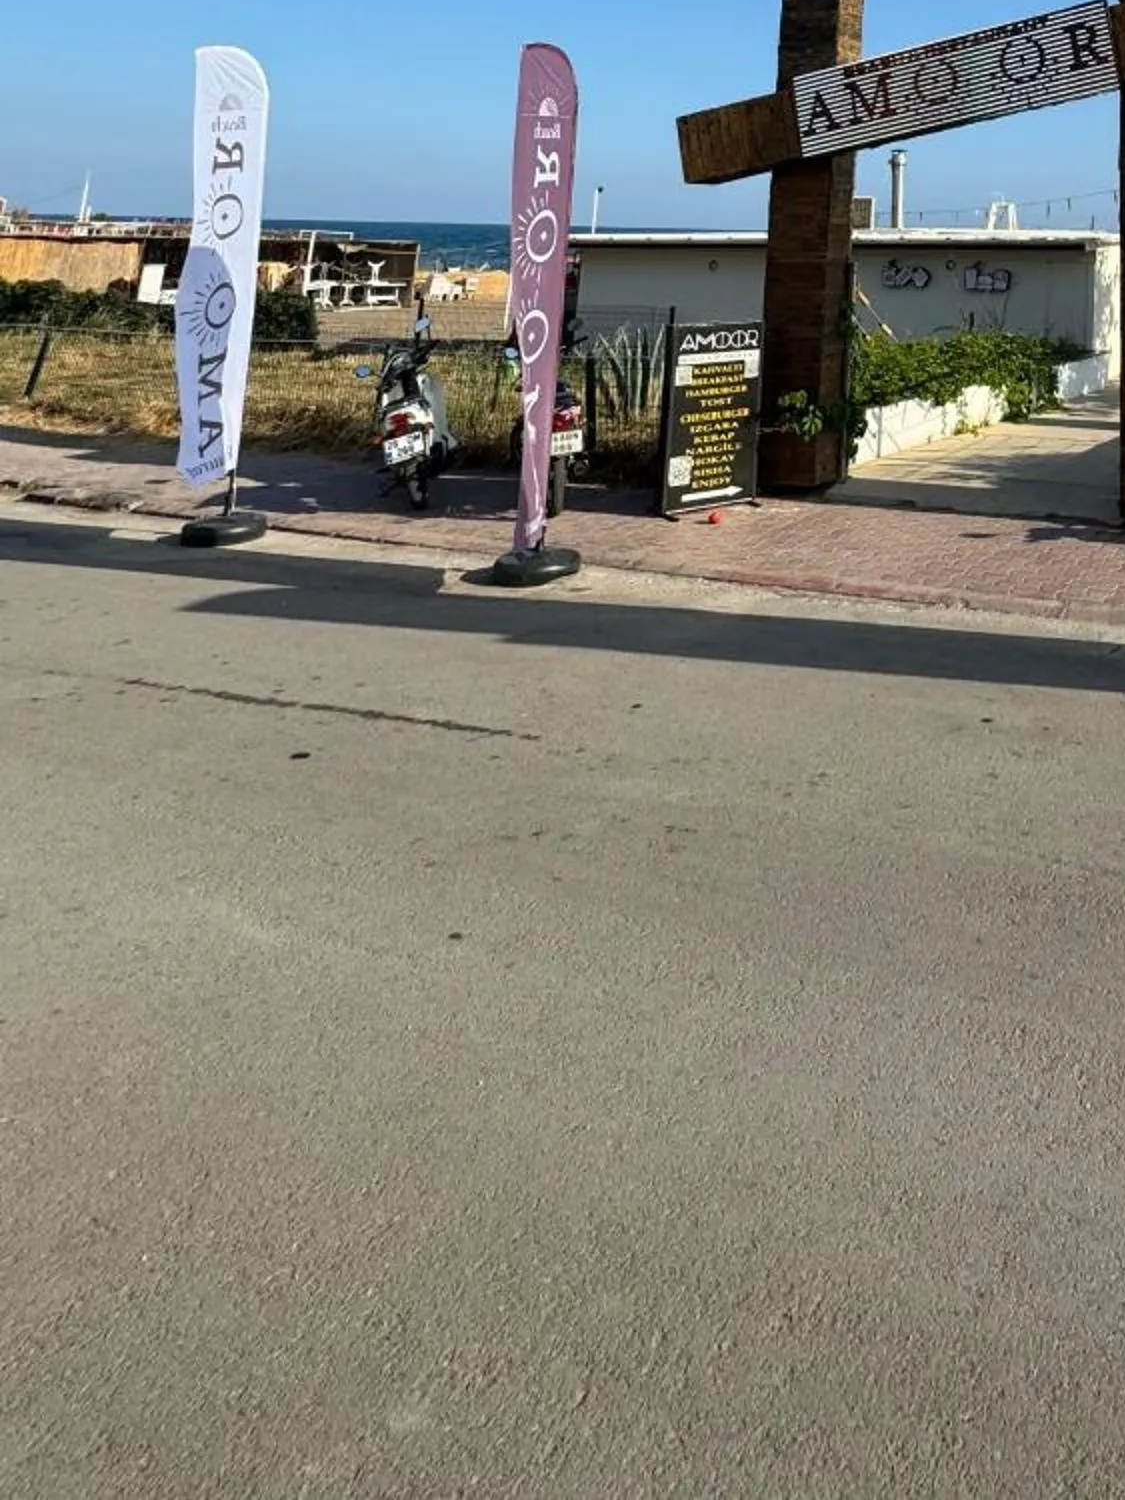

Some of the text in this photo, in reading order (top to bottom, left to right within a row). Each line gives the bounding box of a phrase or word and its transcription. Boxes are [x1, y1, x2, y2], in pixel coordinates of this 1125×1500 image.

[680, 329, 759, 351] AMOOR
[700, 397, 731, 407] TOST
[694, 432, 735, 444] KEBAP
